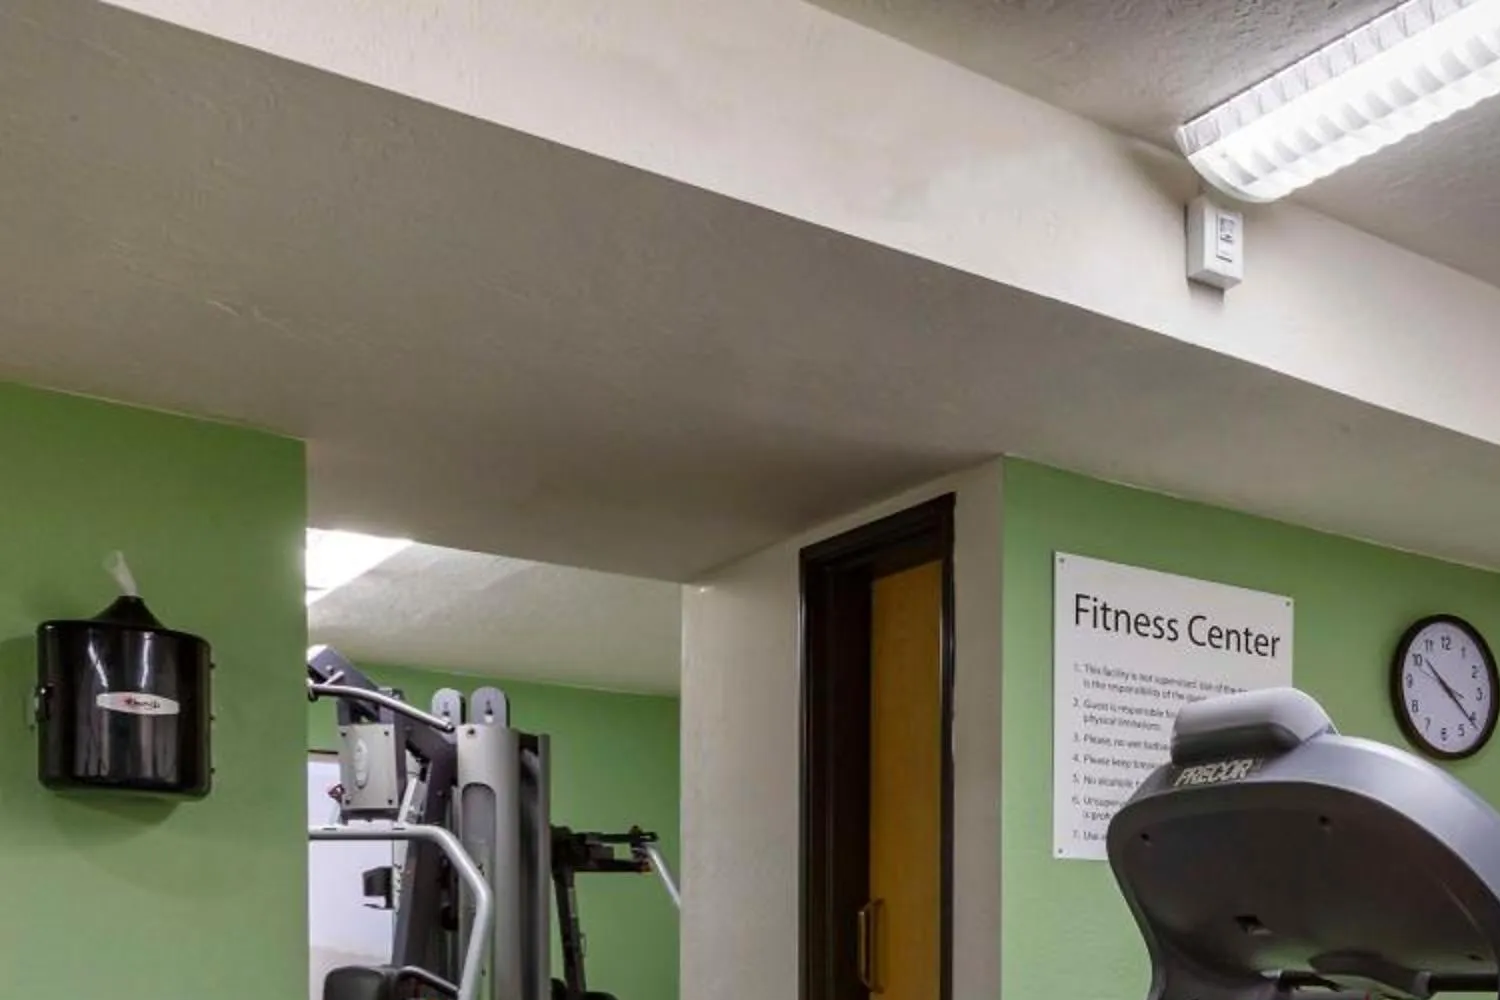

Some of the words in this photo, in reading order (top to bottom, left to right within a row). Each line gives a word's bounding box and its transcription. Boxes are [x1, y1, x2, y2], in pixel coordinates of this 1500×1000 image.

[1074, 593, 1179, 642] Fitness
[1188, 615, 1281, 658] Center
[1441, 635, 1451, 650] 12
[1412, 653, 1423, 667] 10
[1471, 665, 1479, 679] 2
[1476, 687, 1483, 700] 3
[1411, 700, 1419, 713] 8
[1458, 724, 1465, 737] 5
